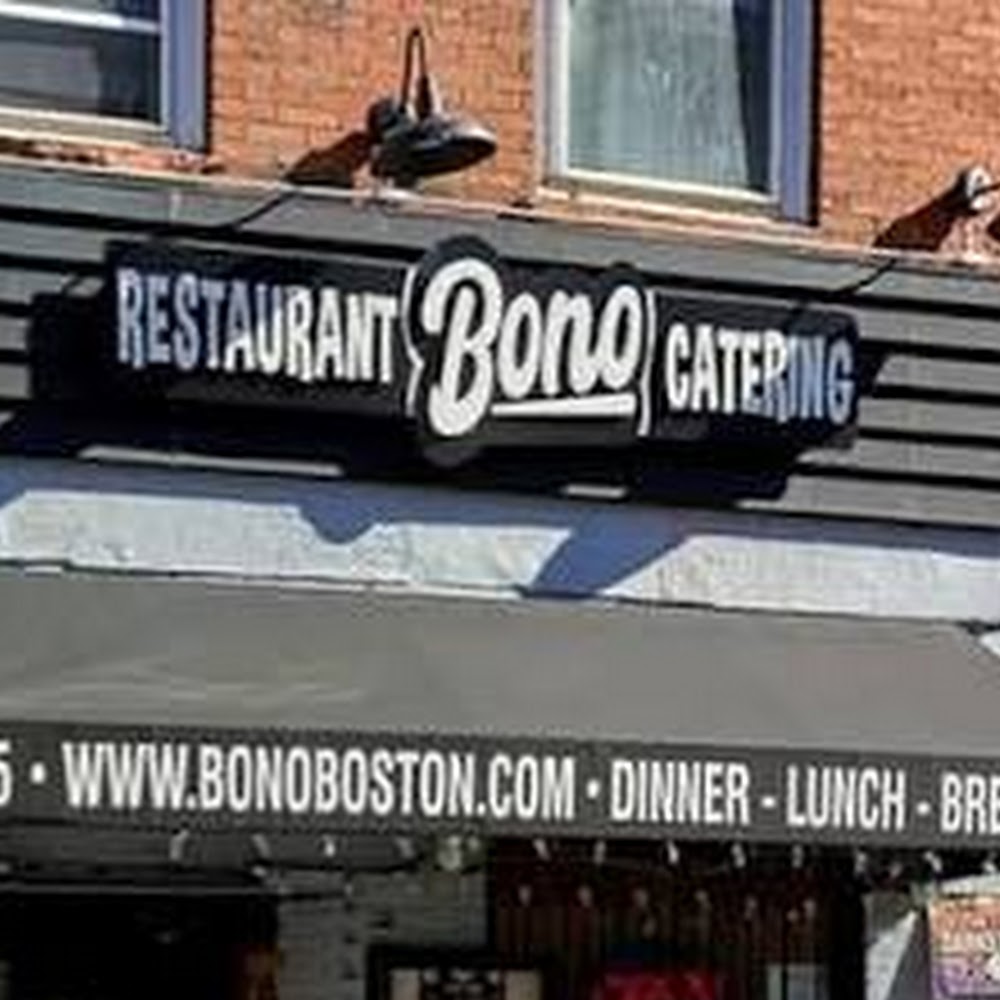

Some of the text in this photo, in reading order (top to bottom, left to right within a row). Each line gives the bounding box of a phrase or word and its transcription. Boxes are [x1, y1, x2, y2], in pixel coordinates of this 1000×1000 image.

[117, 258, 855, 437] RESTAURANT Bono CATERING
[63, 742, 575, 820] WWW.BONOBOSTON.COM
[610, 759, 750, 826] DINNER
[786, 766, 906, 832] LUNCH
